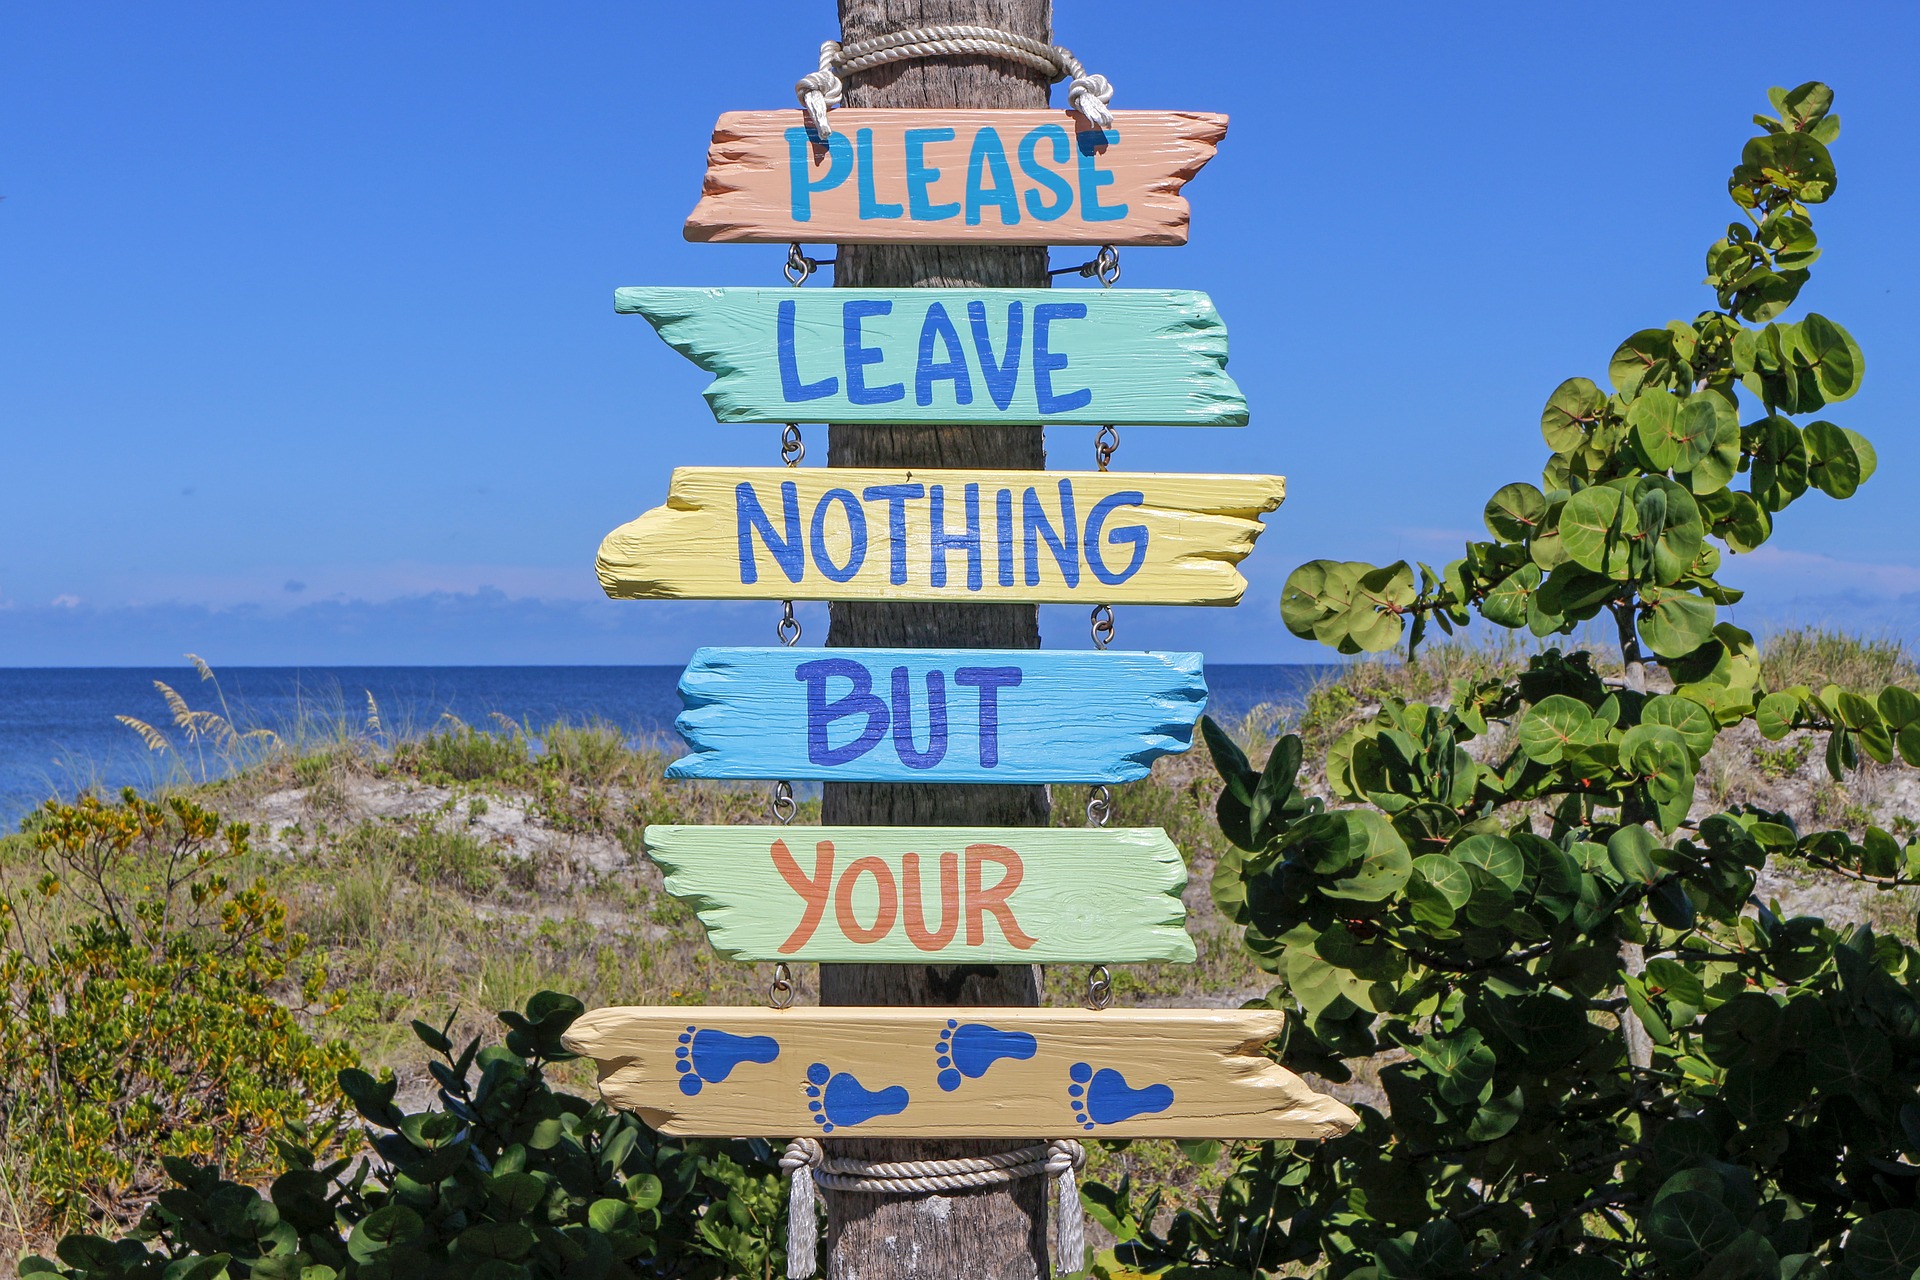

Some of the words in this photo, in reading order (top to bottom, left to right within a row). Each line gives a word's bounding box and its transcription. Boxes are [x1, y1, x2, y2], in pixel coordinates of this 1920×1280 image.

[784, 124, 1128, 226] PLEASE
[778, 299, 1091, 414] LEAVE
[735, 478, 1149, 591] NOTHING
[795, 658, 1022, 769] BUT
[771, 838, 1038, 954] YOUR
